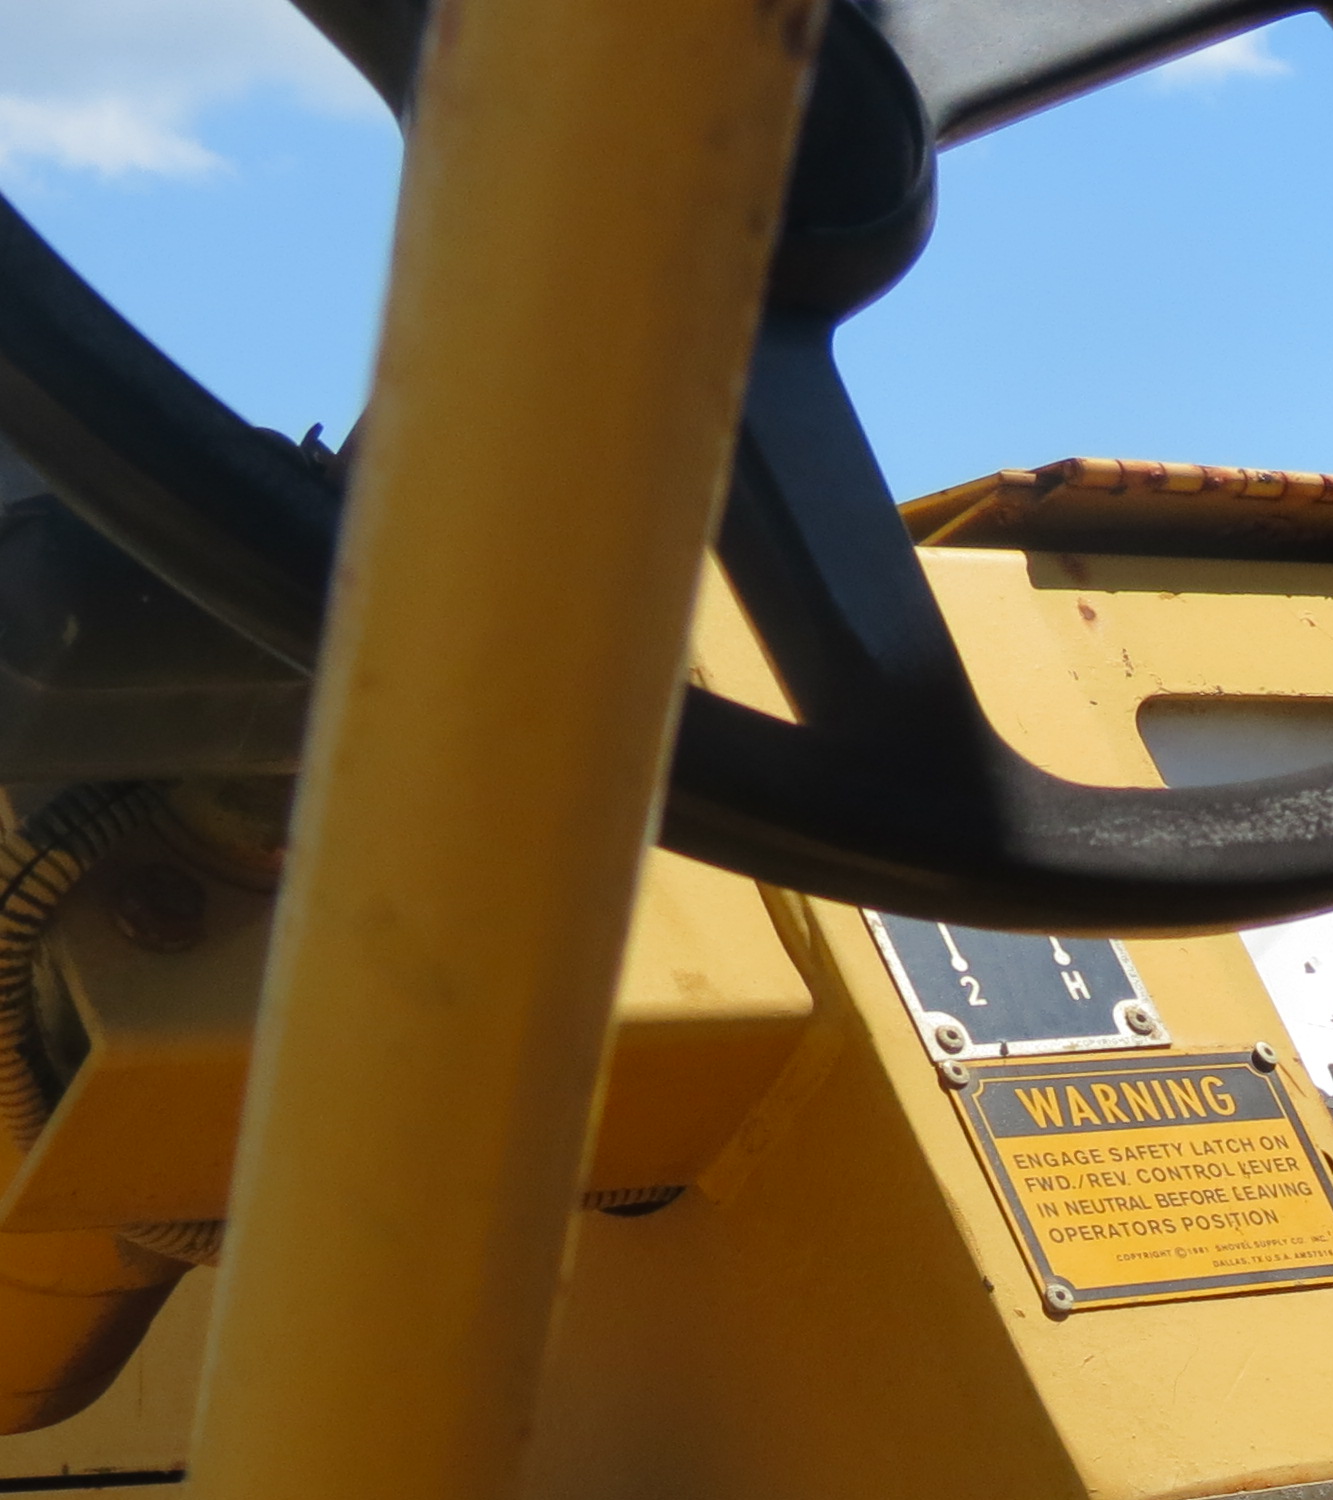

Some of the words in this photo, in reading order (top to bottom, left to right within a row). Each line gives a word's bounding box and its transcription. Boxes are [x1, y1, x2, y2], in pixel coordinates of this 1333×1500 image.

[959, 975, 988, 1006] 2
[1060, 969, 1092, 1001] H
[1014, 1076, 1237, 1128] WARNING
[1011, 1148, 1106, 1170] ENGAGE
[1106, 1142, 1187, 1162] SAFETY
[1188, 1137, 1256, 1156] LATCH
[1256, 1134, 1290, 1151] ON
[1023, 1170, 1132, 1193] FWD./REV.
[1133, 1161, 1237, 1185] CONTROL
[1236, 1156, 1302, 1177] LEVER
[1035, 1201, 1060, 1218] IN
[1063, 1194, 1153, 1216] NEUTRAL
[1153, 1187, 1231, 1208] BEFORE
[1230, 1180, 1314, 1201] LEAVING
[1046, 1217, 1179, 1244] OPERATORS
[1179, 1208, 1281, 1232] POSITION
[1113, 1248, 1175, 1262] COPYRIGHT
